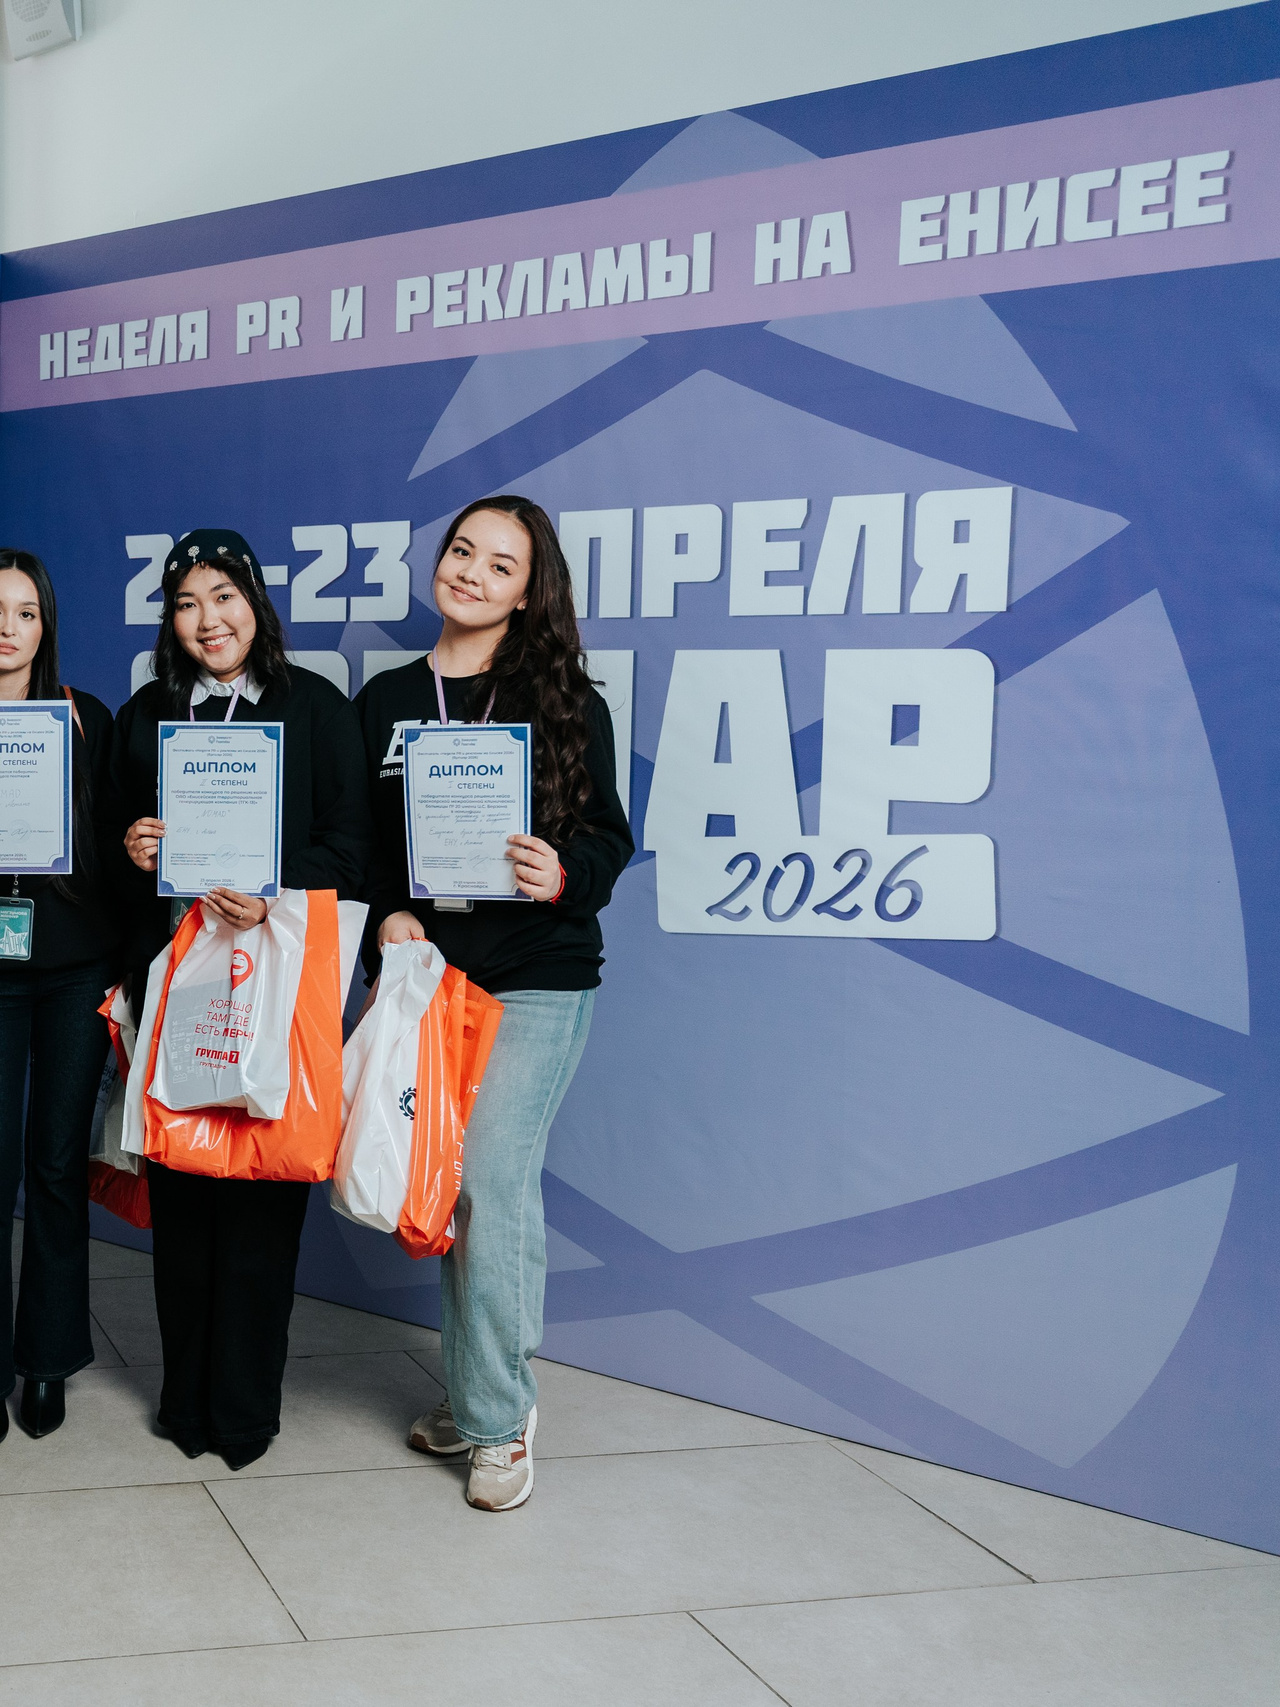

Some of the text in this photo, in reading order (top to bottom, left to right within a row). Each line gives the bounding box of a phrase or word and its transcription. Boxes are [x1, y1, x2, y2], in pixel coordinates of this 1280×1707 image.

[39, 149, 1231, 380] НЕДЕЛЯ PR И РЕКЛАМЫ НА ЕНИСЕЕ
[124, 486, 1013, 625] 2-23 ПРЕЛЯ
[183, 761, 256, 774] ДИПЛОМ
[429, 764, 503, 778] ДИПЛОМ
[705, 844, 930, 923] 2026
[195, 1024, 220, 1036] ЕСТЬ
